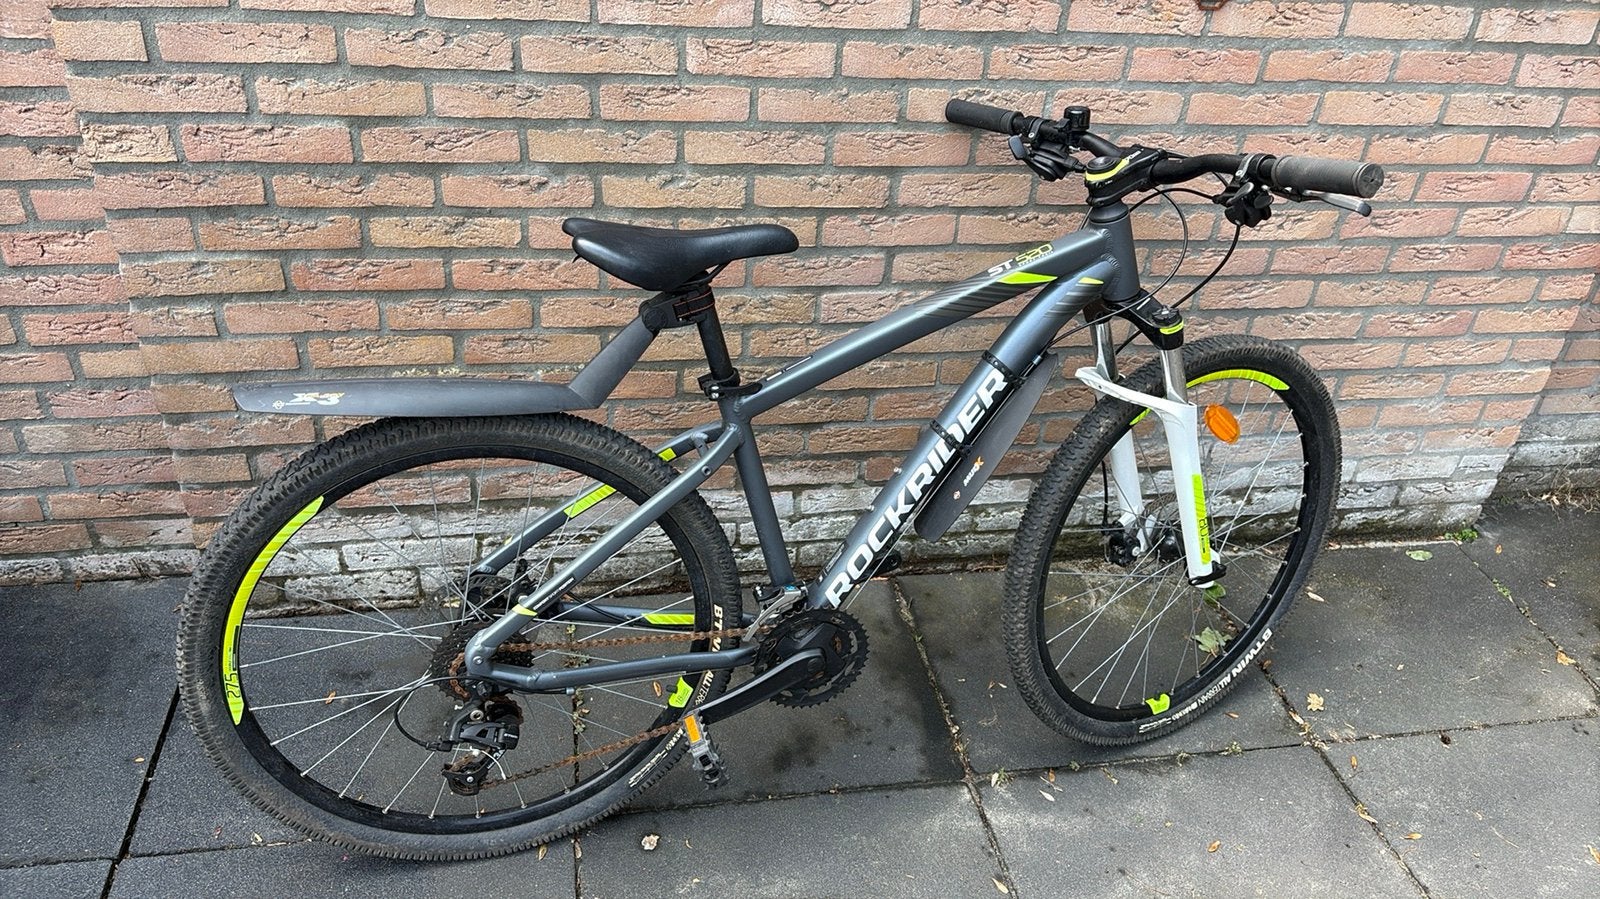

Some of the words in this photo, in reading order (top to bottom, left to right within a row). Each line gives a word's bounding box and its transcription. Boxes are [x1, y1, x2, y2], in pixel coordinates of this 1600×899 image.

[987, 259, 1014, 277] ST
[1015, 243, 1053, 263] 520
[825, 367, 1008, 608] ROCKRIDER
